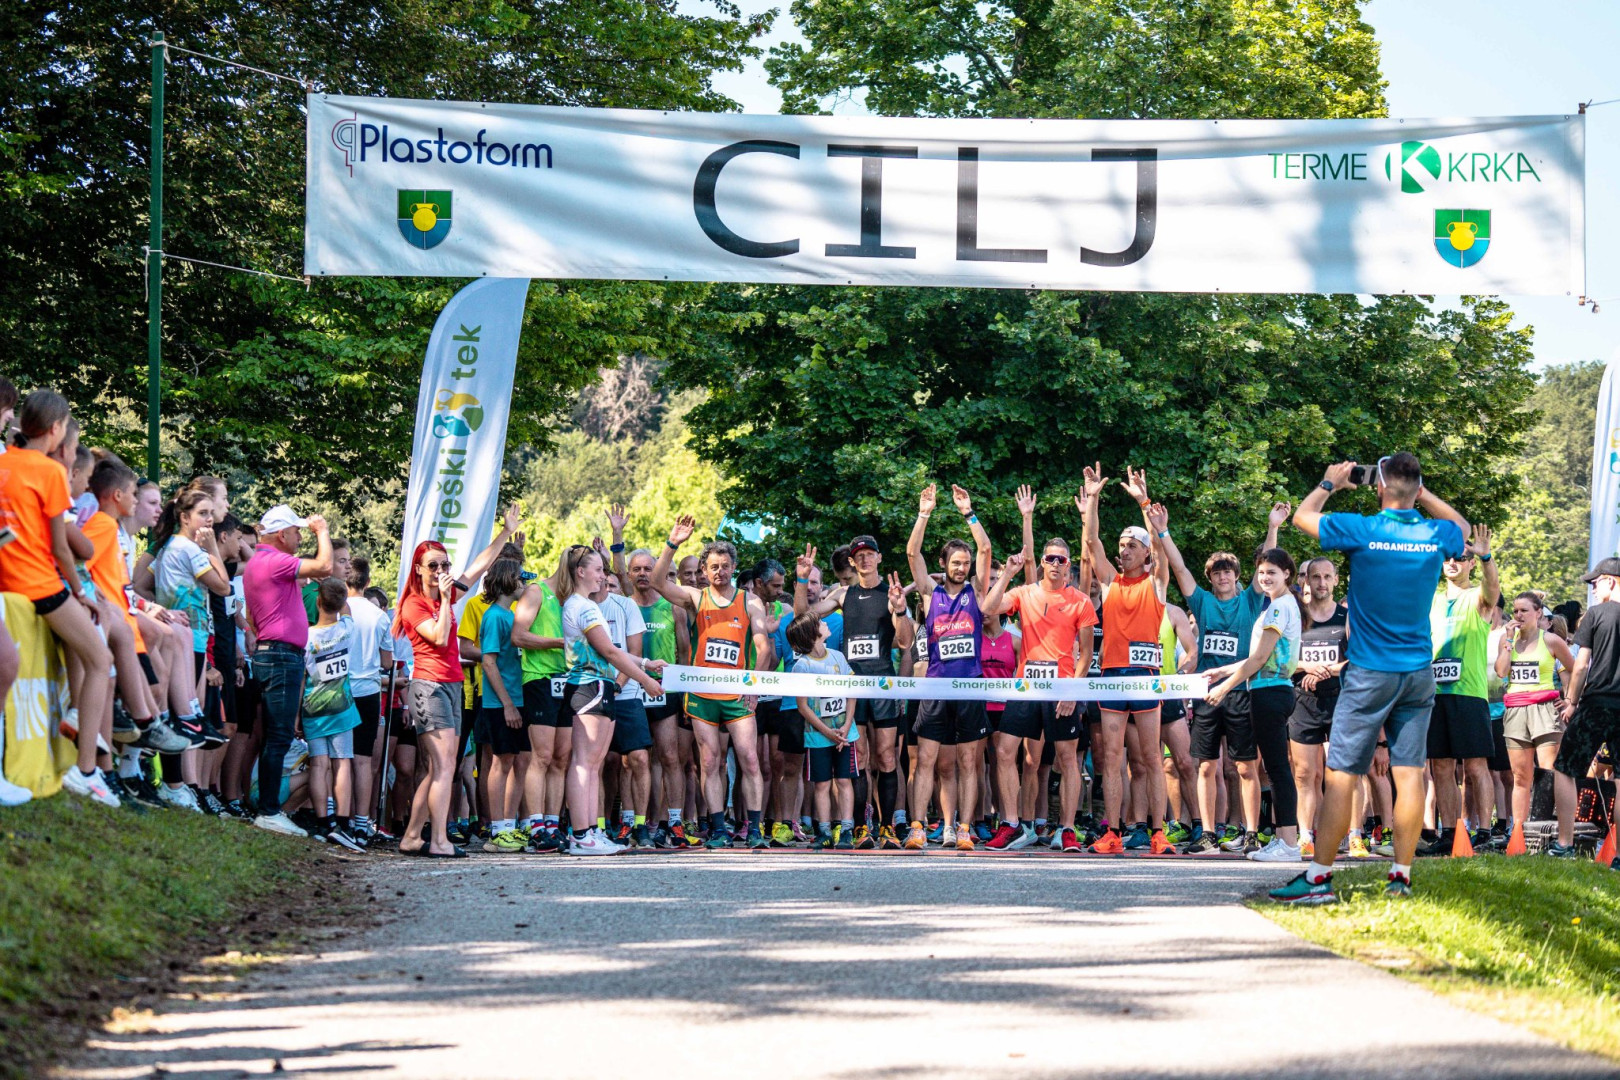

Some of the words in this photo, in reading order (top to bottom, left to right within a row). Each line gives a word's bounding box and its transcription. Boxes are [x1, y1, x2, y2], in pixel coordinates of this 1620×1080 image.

[360, 124, 553, 169] Plastoform
[1268, 152, 1367, 182] TERME
[1449, 153, 1542, 183] KRKA
[694, 140, 1158, 265] CILJ
[451, 323, 482, 379] tek
[1368, 541, 1438, 553] ORGANIZATOR
[851, 643, 873, 655] 433
[941, 642, 973, 656] 3262
[1205, 638, 1235, 652] 3133
[707, 646, 737, 661] 3116
[1304, 649, 1337, 662] 3310
[325, 659, 347, 675] 479
[679, 672, 739, 684] Šmarješki
[761, 676, 780, 684] tek
[815, 677, 876, 688] Šmarješki
[897, 679, 916, 688] tek
[952, 679, 1012, 690] Šmarješki
[1033, 680, 1053, 690] tek
[1088, 680, 1149, 692] Šmarješki
[1170, 682, 1190, 691] tek
[824, 698, 843, 713] 422
